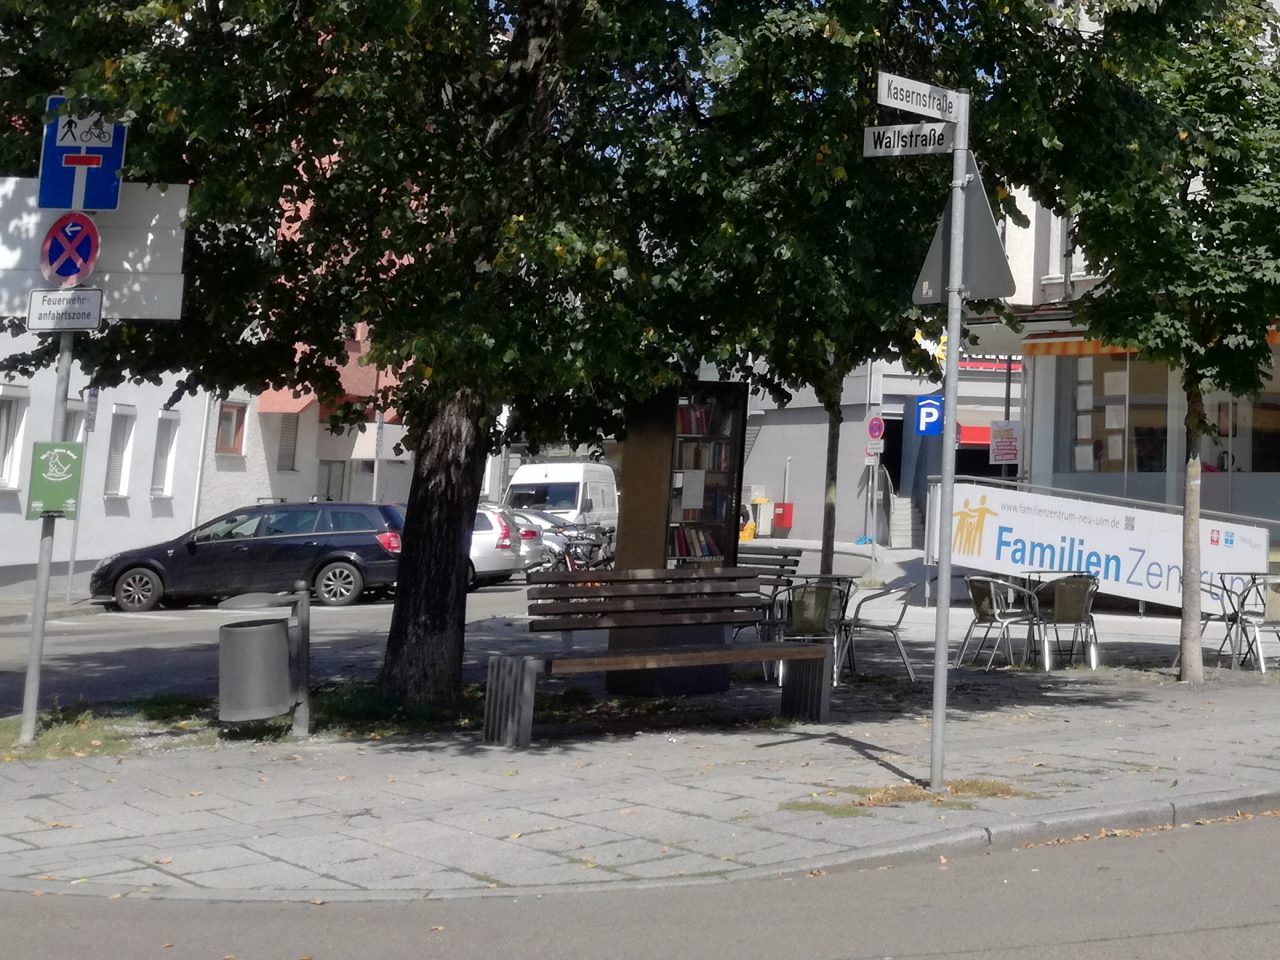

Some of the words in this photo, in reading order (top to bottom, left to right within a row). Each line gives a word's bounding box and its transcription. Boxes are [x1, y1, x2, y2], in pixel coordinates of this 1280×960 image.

[887, 79, 953, 114] Kasernstraße
[872, 128, 945, 150] Wallstraße
[37, 310, 92, 321] anfahrtszone
[919, 408, 939, 431] P
[1000, 502, 1120, 529] www.familienzentrum-neu-ulm.de
